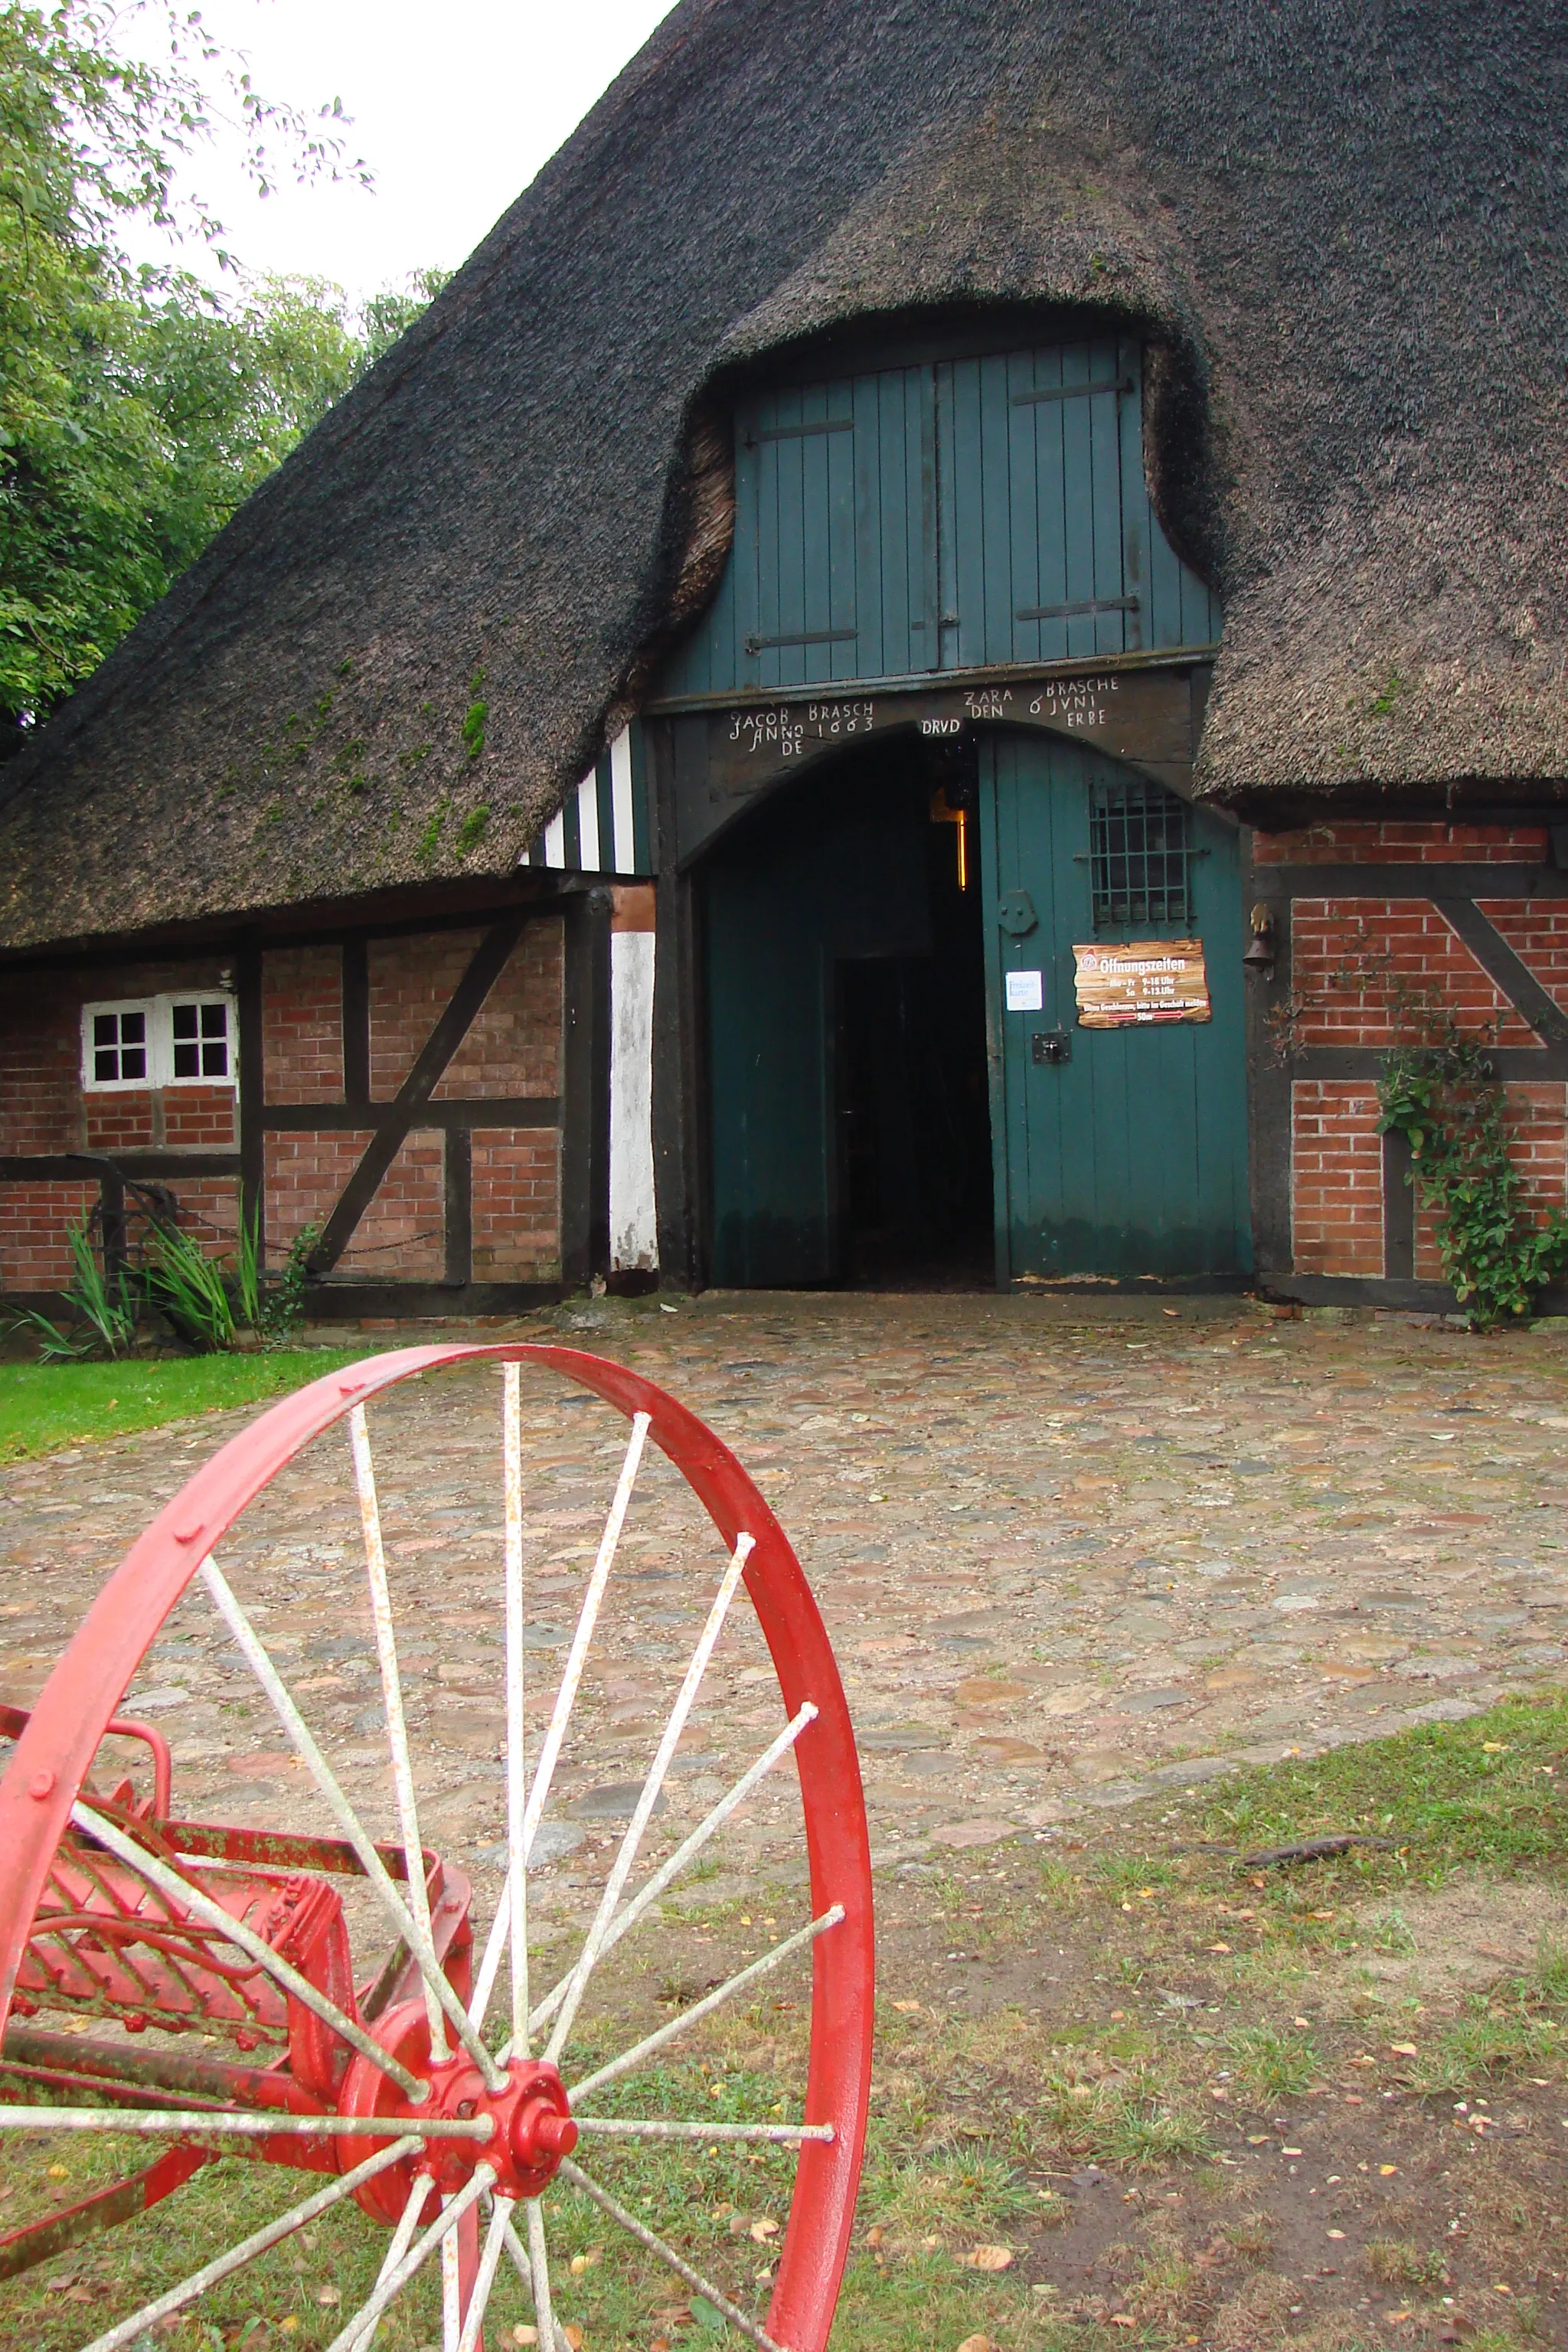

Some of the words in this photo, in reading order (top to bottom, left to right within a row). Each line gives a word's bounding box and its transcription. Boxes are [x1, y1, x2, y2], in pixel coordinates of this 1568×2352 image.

[730, 707, 789, 740] JACOB
[808, 702, 873, 721] BRASCH
[964, 689, 1012, 706] ZARA
[1046, 677, 1119, 697] BRASCHE
[749, 724, 804, 753] ANNO
[818, 717, 874, 737] 1663
[972, 704, 1003, 719] DEN
[1030, 695, 1044, 714] 6
[782, 740, 802, 756] DE
[921, 718, 960, 734] DRVD
[1067, 709, 1106, 727] ERBE
[1099, 956, 1185, 976] Öffnungszeiten
[1161, 976, 1174, 985] Uhr
[1125, 988, 1135, 997] Sa
